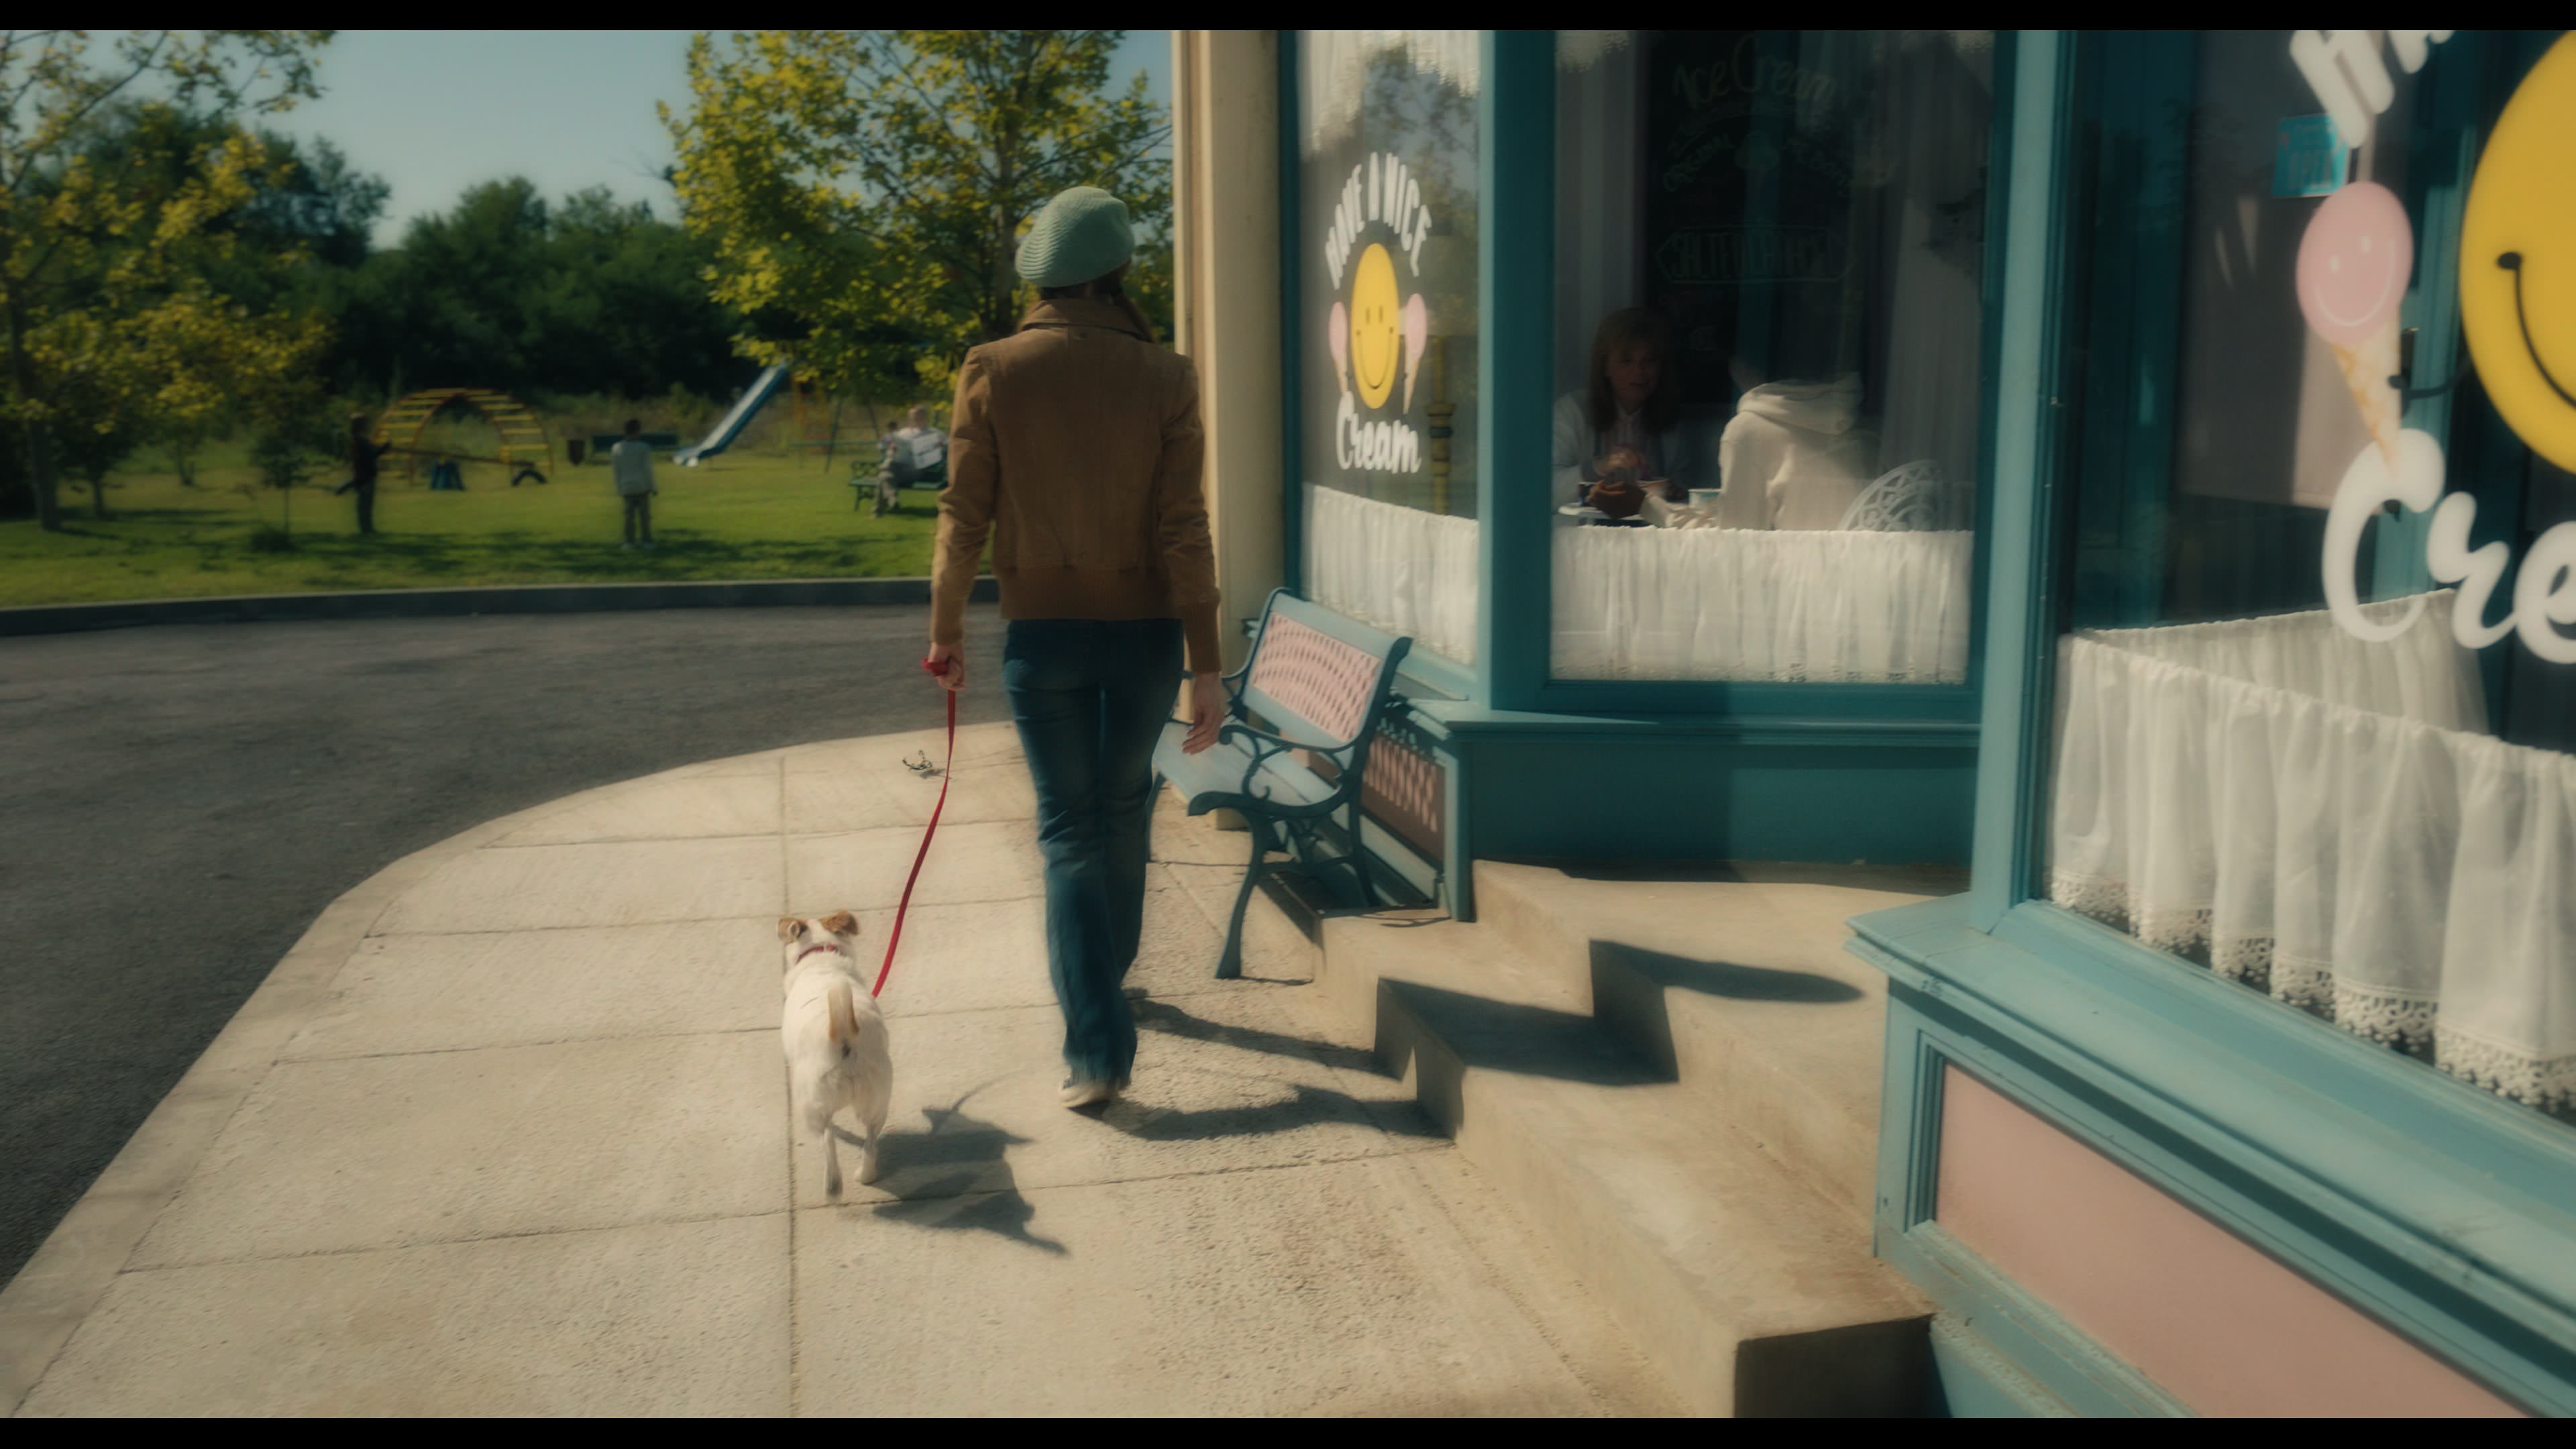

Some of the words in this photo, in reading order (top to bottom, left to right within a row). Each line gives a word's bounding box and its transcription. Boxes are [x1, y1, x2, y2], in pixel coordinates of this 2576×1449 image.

[1325, 164, 1366, 290] HAVE
[1368, 151, 1380, 221] A
[1383, 152, 1432, 277] NICE
[1336, 390, 1422, 474] Cream
